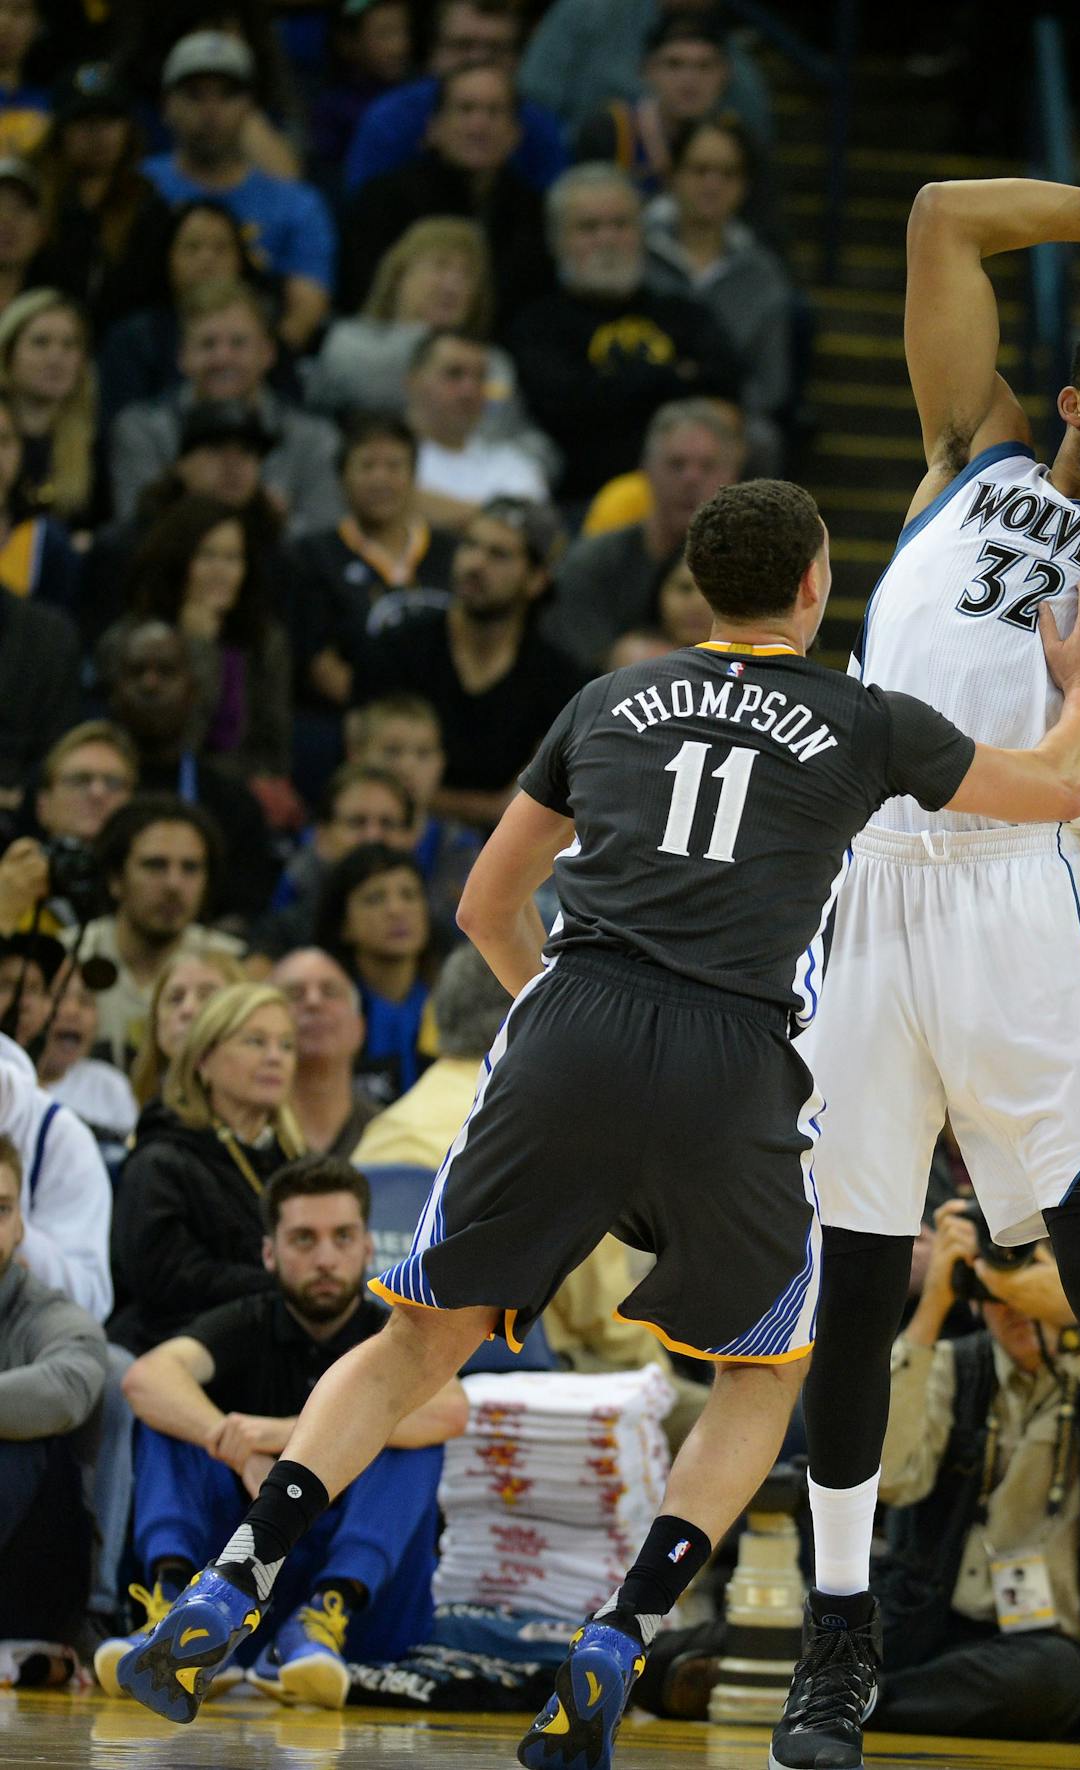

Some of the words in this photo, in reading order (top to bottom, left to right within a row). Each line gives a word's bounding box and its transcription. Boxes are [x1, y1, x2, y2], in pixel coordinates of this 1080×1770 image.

[955, 540, 1065, 632] 32
[611, 679, 838, 763] THOMPSON
[657, 740, 760, 863] 11
